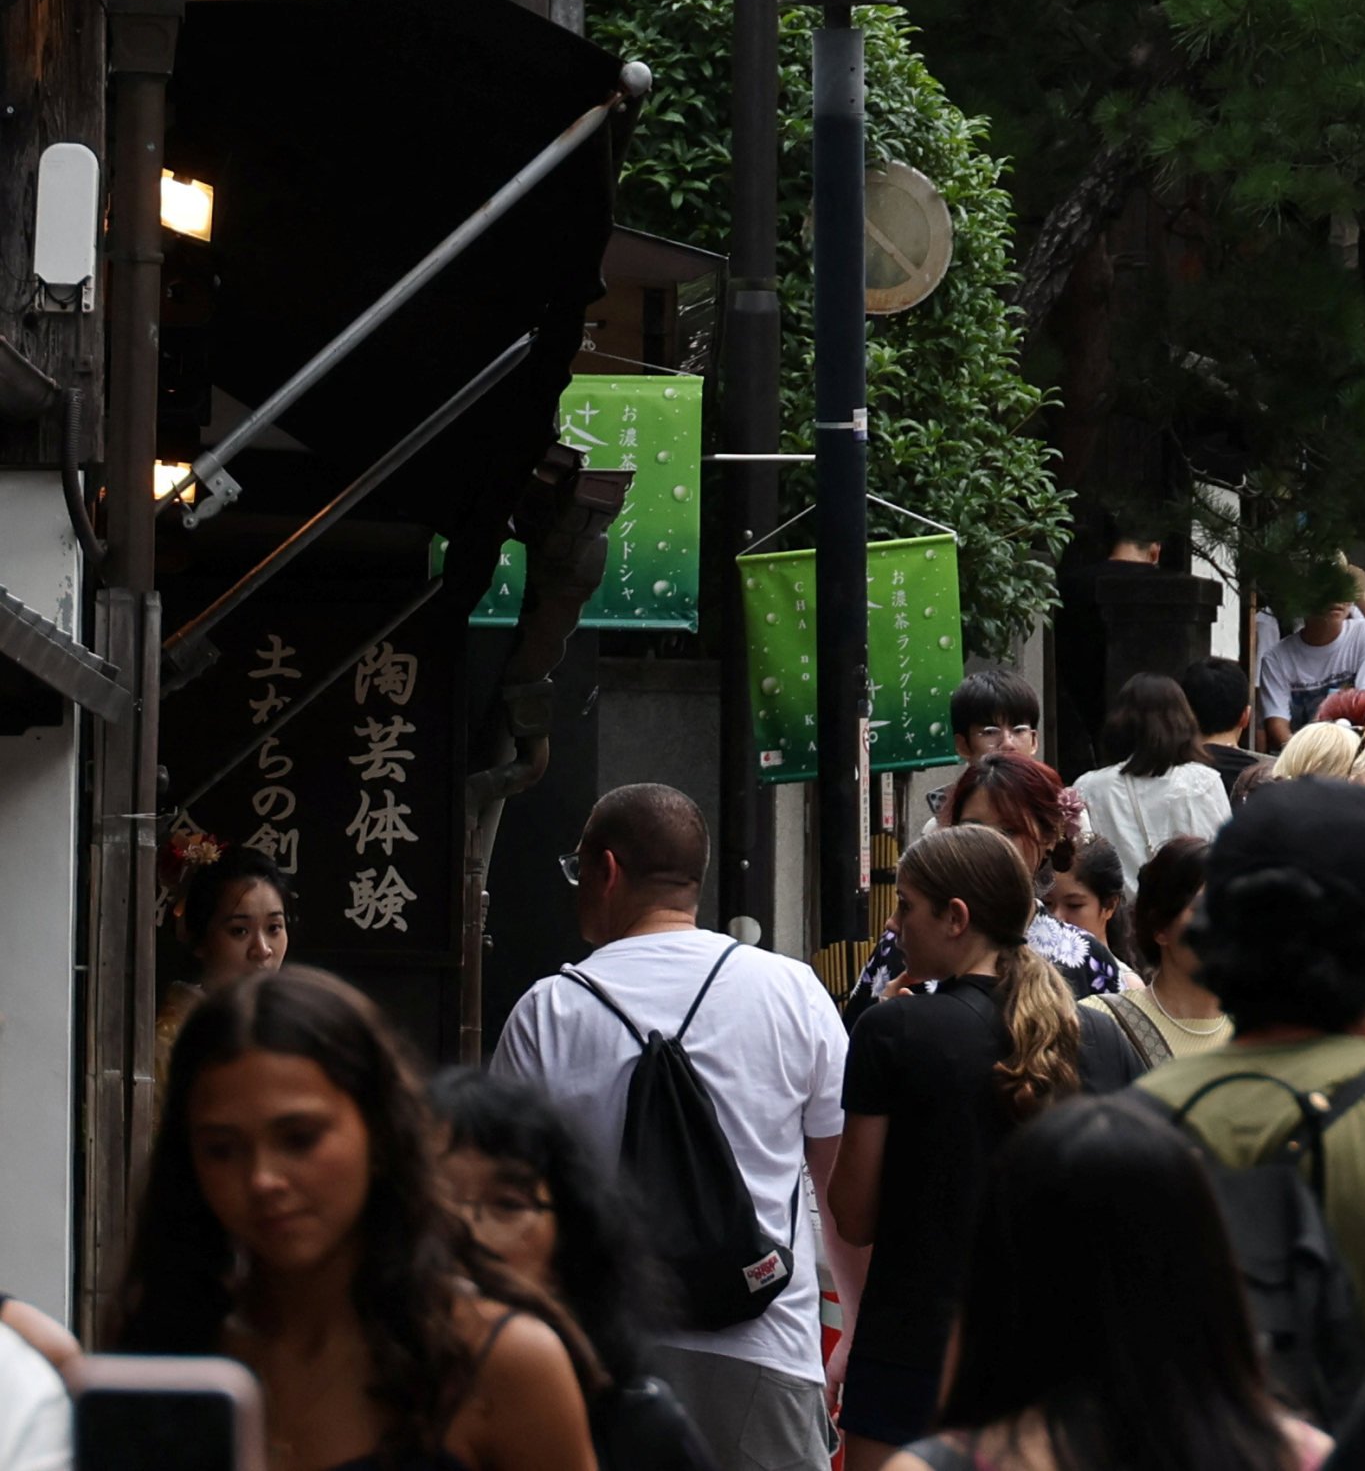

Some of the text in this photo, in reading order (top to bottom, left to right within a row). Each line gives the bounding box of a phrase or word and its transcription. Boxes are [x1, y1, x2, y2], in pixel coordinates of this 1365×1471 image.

[891, 569, 916, 744] お濃茶ラングドシャ
[345, 640, 420, 933] 陶芸体験
